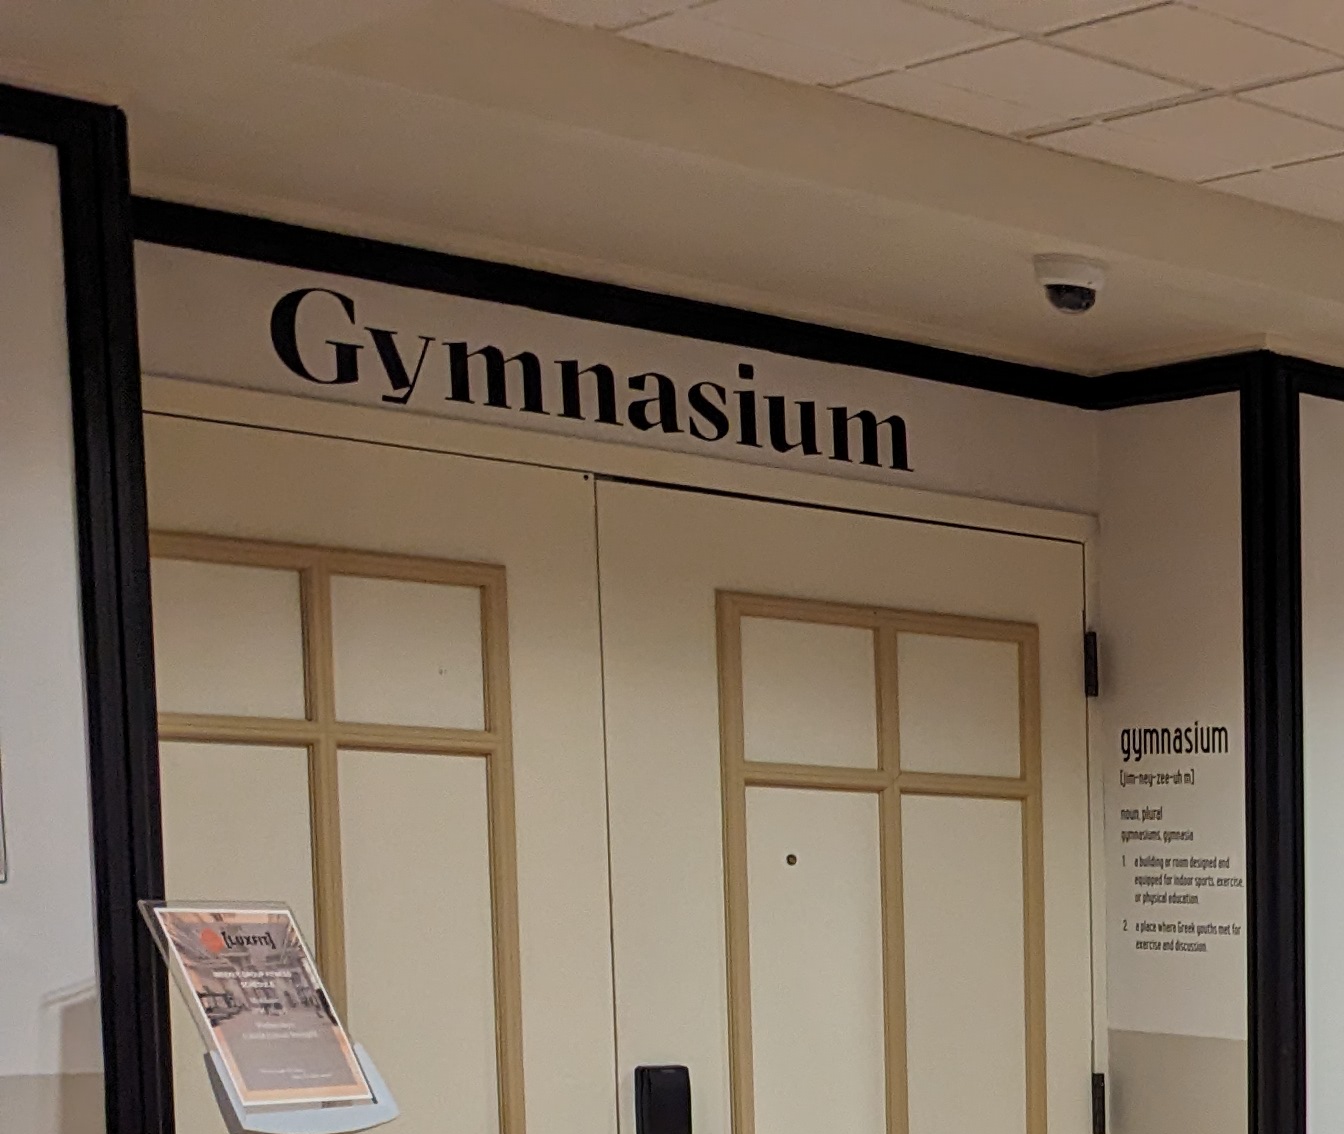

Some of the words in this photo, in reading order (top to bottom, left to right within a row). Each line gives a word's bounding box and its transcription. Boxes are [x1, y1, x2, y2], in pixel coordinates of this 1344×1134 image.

[270, 286, 914, 473] Gymnasium
[1120, 720, 1229, 762] gymnasium
[1142, 805, 1163, 823] plural
[1163, 830, 1194, 843] gymnasia
[1122, 854, 1126, 867] 1
[1134, 858, 1138, 867] a
[1140, 855, 1164, 869] building
[1165, 858, 1171, 867] or
[1173, 858, 1188, 868] room
[1190, 856, 1217, 870] designed
[1218, 857, 1230, 868] and
[1135, 874, 1162, 887] equipped
[1164, 874, 1173, 886] for
[1174, 874, 1193, 886] indoor
[1135, 893, 1141, 902] or
[1142, 891, 1167, 905] physical
[1123, 919, 1128, 931] 2
[1135, 922, 1139, 931] a
[1140, 920, 1156, 933] place
[1158, 921, 1176, 933] where
[1177, 920, 1195, 934] Greek
[1197, 923, 1217, 936] youths
[1218, 924, 1230, 935] met
[1232, 923, 1241, 935] for
[1135, 940, 1161, 951] exercise
[1162, 939, 1174, 951] and
